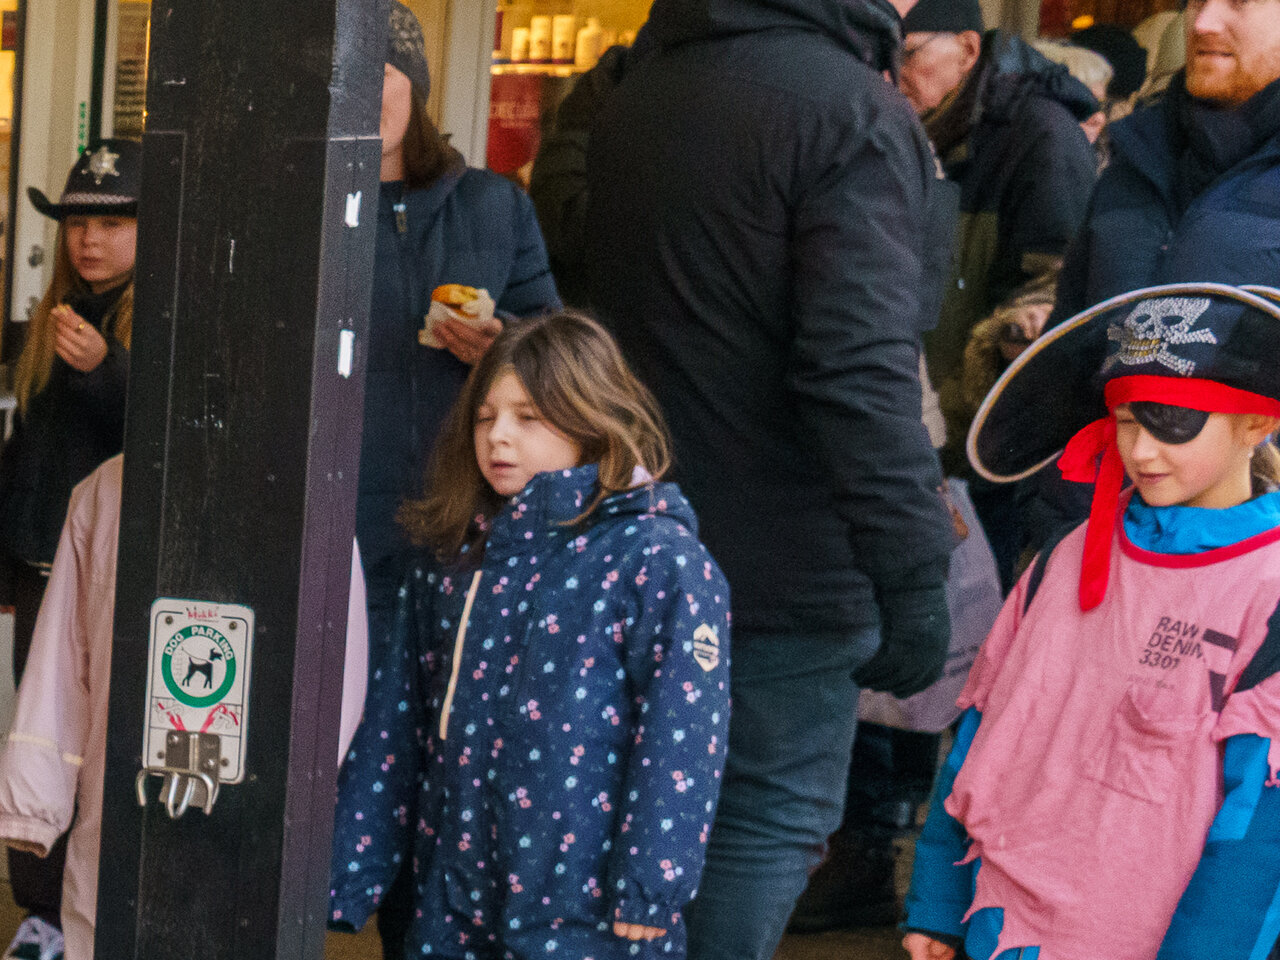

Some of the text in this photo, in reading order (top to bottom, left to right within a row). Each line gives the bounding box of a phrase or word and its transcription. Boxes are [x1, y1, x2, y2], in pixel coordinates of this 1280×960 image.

[1156, 616, 1199, 638] RAW
[164, 626, 234, 661] DOG PARKING
